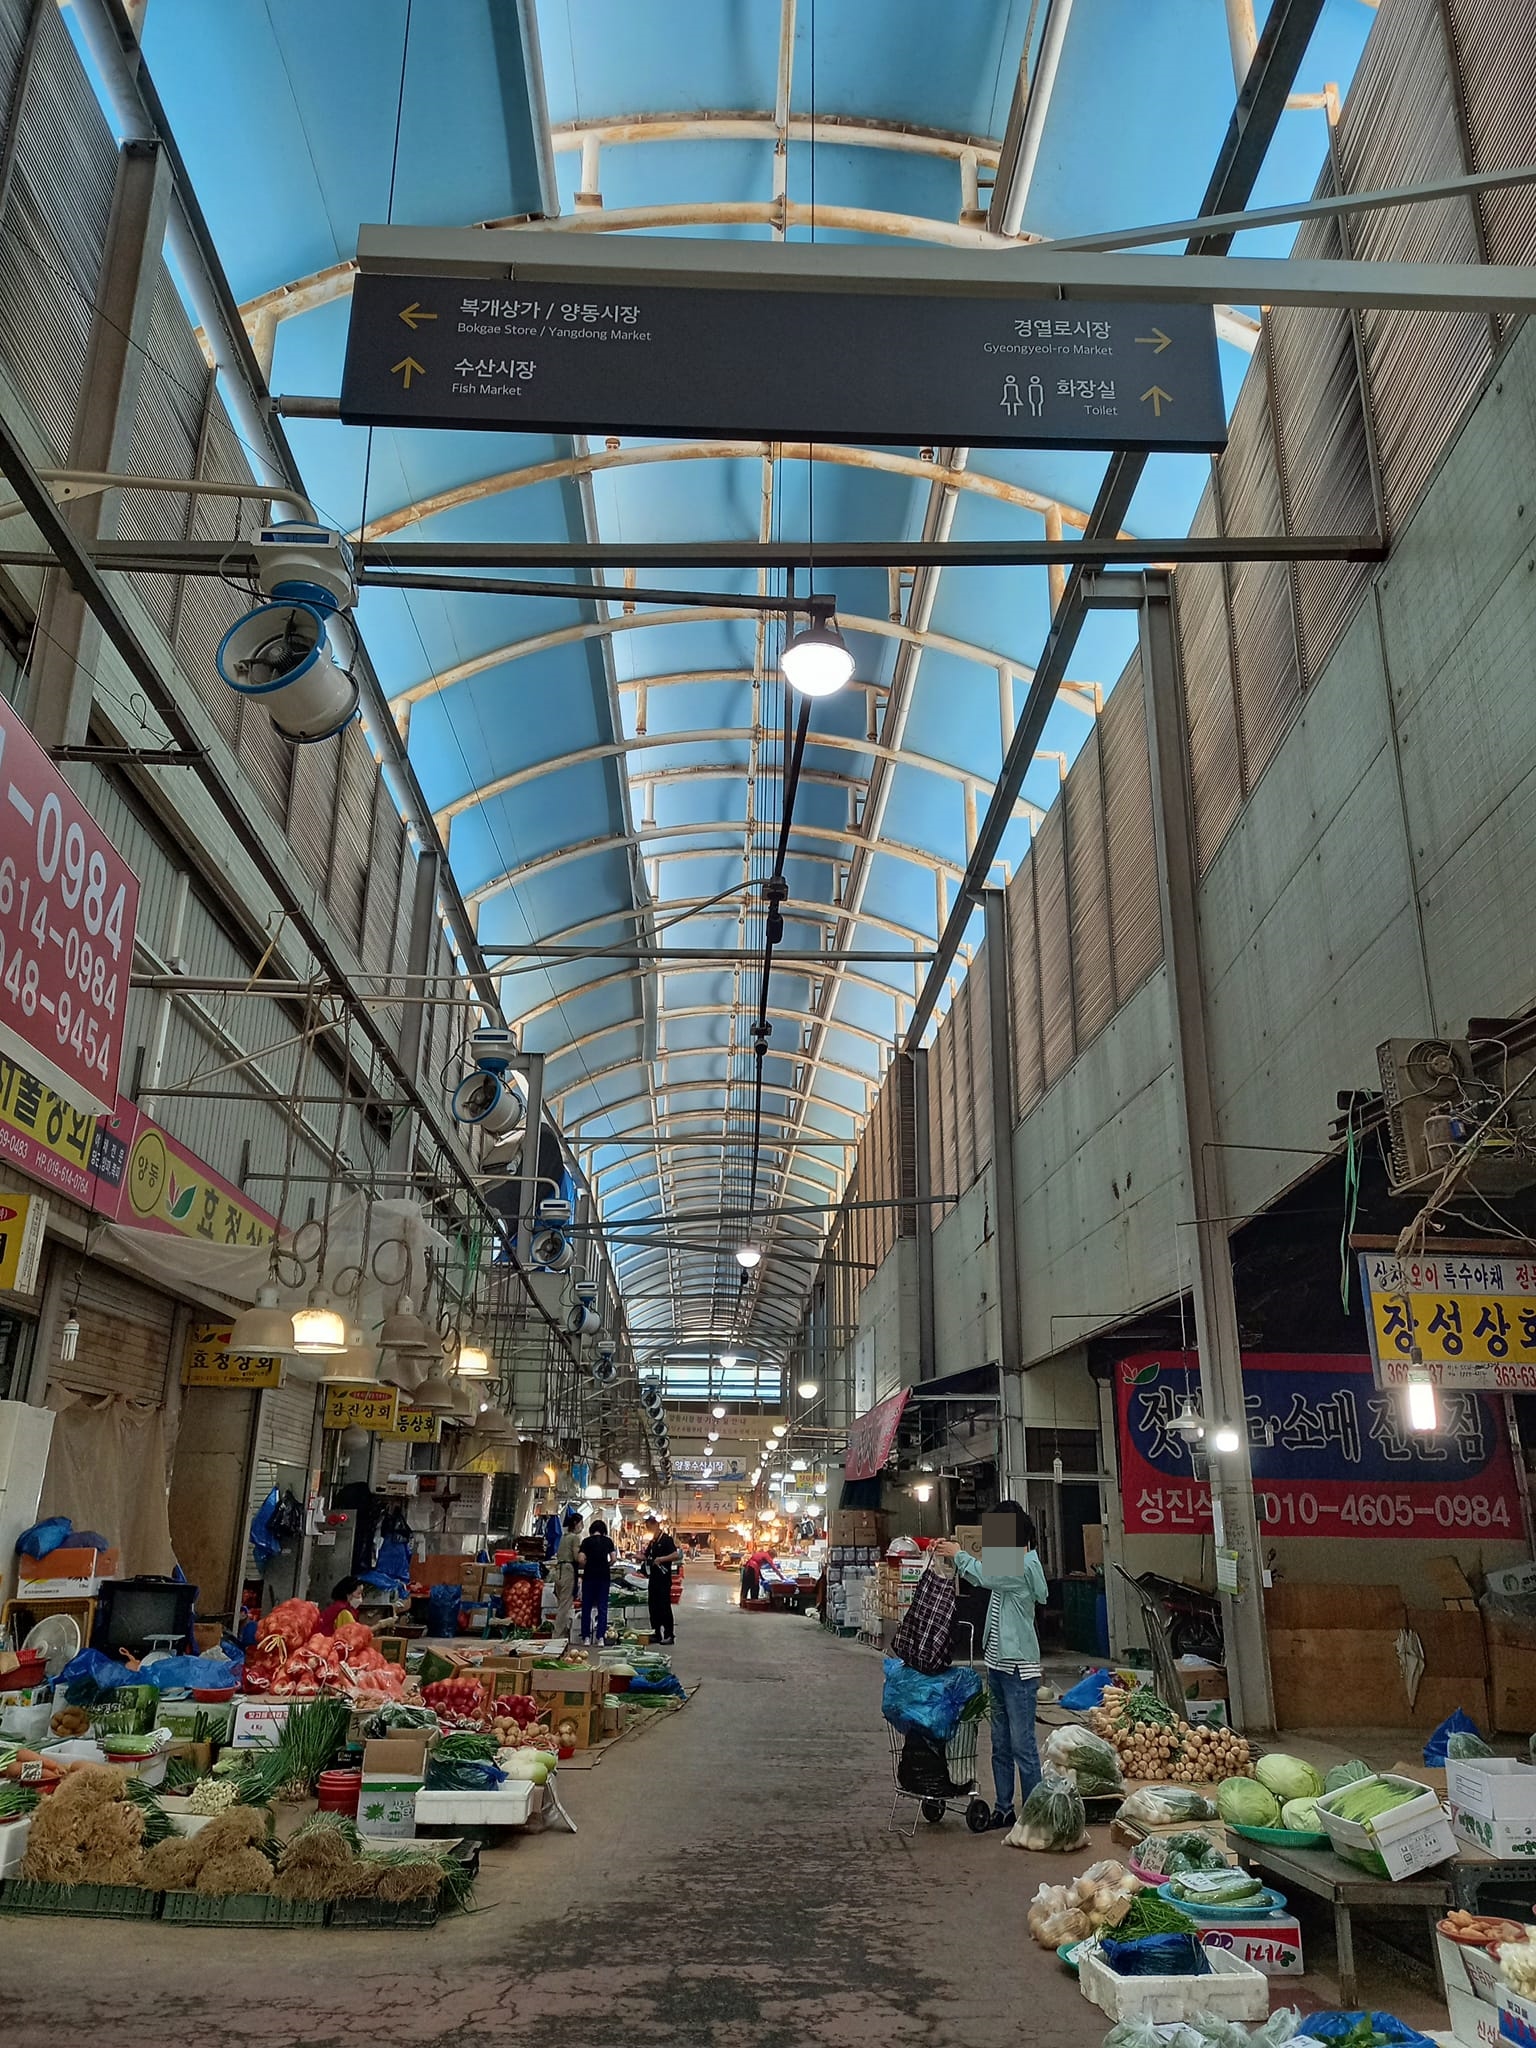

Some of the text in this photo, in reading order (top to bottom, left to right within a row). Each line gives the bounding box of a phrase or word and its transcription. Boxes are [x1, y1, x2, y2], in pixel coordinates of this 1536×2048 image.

[460, 299, 541, 319] 복개상가
[560, 303, 640, 324] 양동시장
[457, 322, 501, 335] Bokgae
[504, 325, 537, 336] Store
[549, 327, 607, 340] Yangdong
[610, 329, 652, 341] Market
[1014, 319, 1111, 339] 경열로시장
[983, 342, 1113, 356] Gyeongyeol-ro Market
[454, 357, 537, 380] 수산시장
[452, 383, 522, 396] Fish Market
[1056, 379, 1117, 399] 화장실
[1084, 405, 1118, 416] Toilet
[0, 728, 126, 962] -0984
[0, 929, 111, 1081] 48-9454
[138, 1156, 159, 1188] 양동
[1411, 1263, 1439, 1289] 오이
[1444, 1262, 1504, 1290] 특수야채
[674, 1460, 724, 1471] 양동수산시장
[1264, 1492, 1511, 1528] 010-4605-0984
